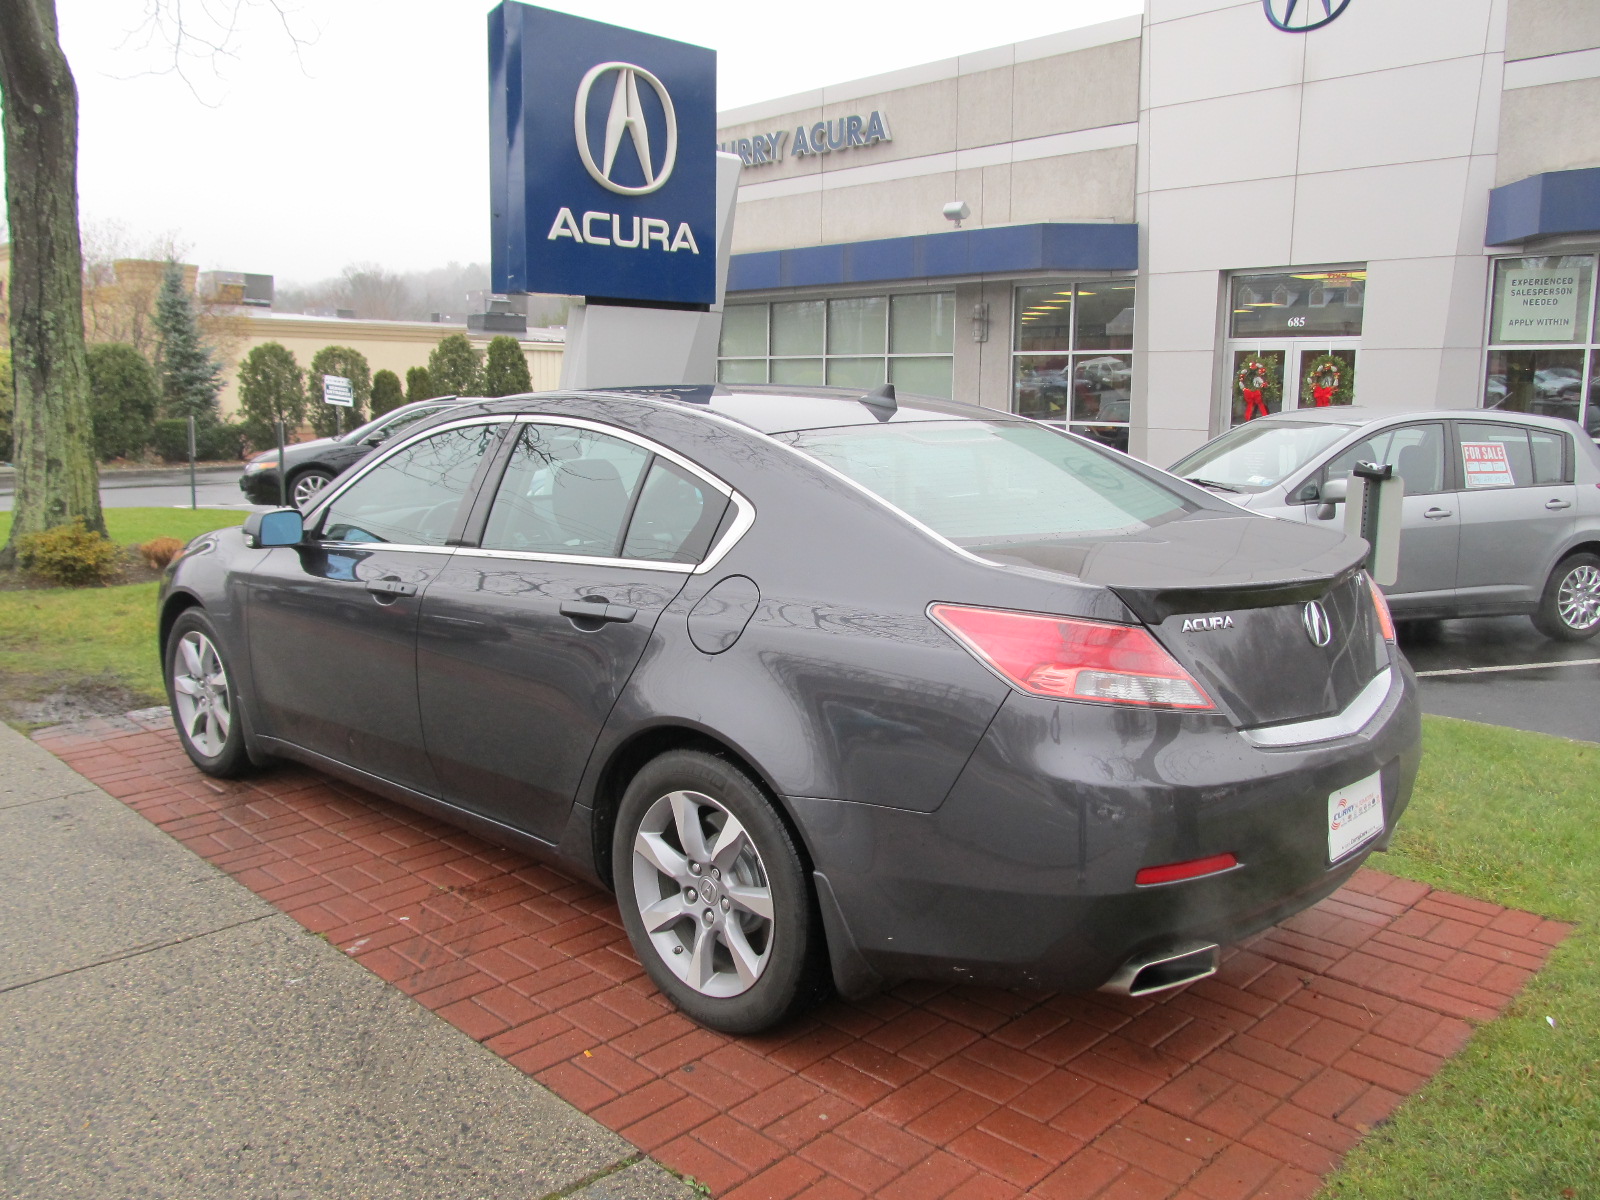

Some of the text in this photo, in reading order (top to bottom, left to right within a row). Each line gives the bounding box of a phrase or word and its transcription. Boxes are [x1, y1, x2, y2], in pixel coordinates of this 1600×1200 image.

[716, 110, 891, 166] RRY ACURA
[547, 207, 699, 254] ACURA
[1511, 277, 1574, 287] EXPERIENCED
[1510, 287, 1573, 297] SALESPERSON
[1522, 298, 1558, 306] NEEDED
[1287, 316, 1306, 328] 685
[1508, 318, 1570, 327] APPLY WITHIN
[1464, 446, 1505, 460] FOR SALE
[1181, 615, 1235, 633] ACURA
[1333, 804, 1355, 821] CURRY
